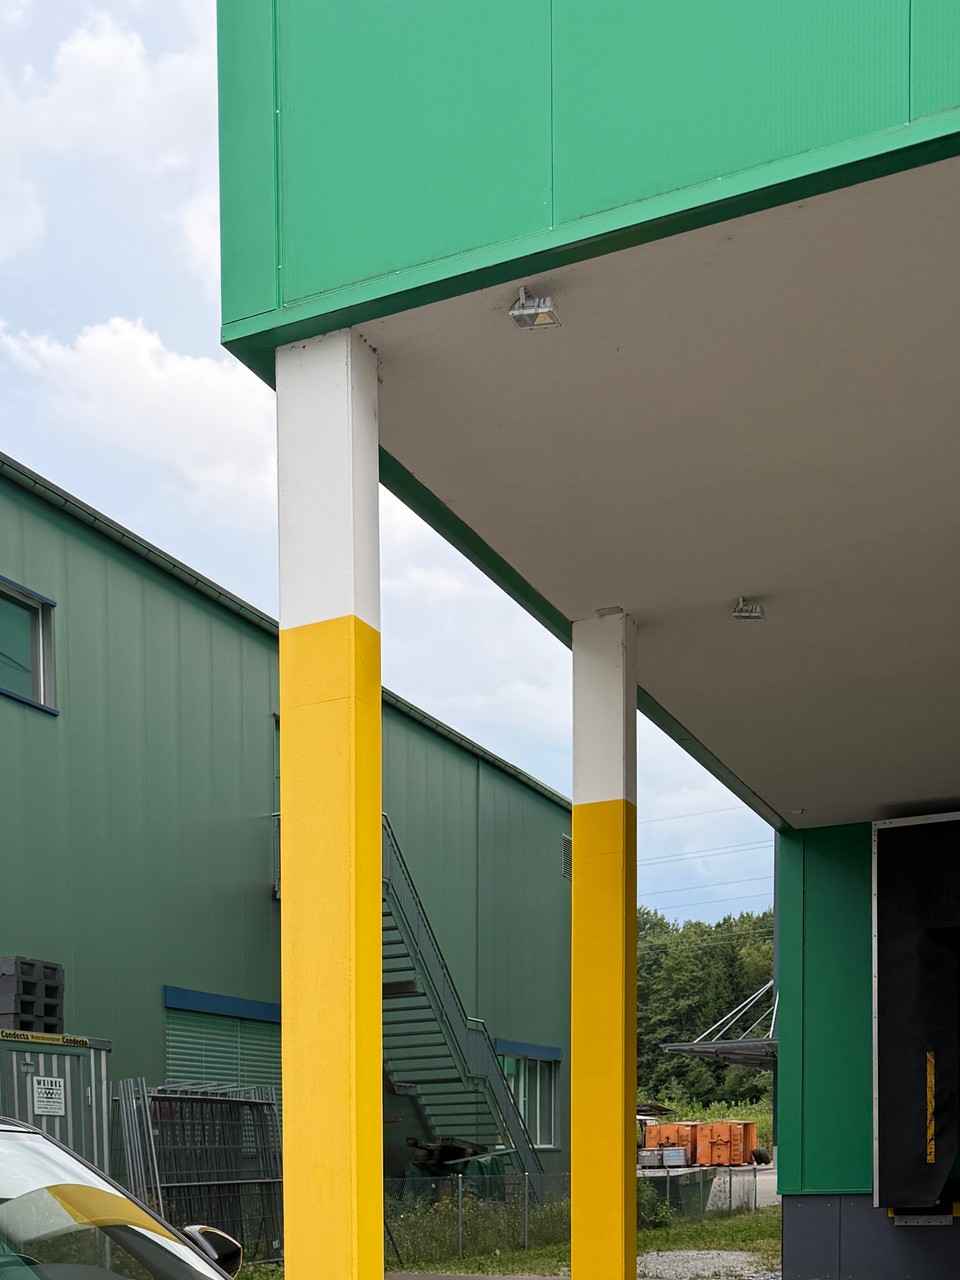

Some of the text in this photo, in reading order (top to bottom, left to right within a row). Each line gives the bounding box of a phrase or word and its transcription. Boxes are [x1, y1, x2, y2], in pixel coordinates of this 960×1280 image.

[0, 1030, 29, 1040] Condecta
[61, 1036, 88, 1046] Condecta
[36, 1079, 62, 1088] WEIBEL
